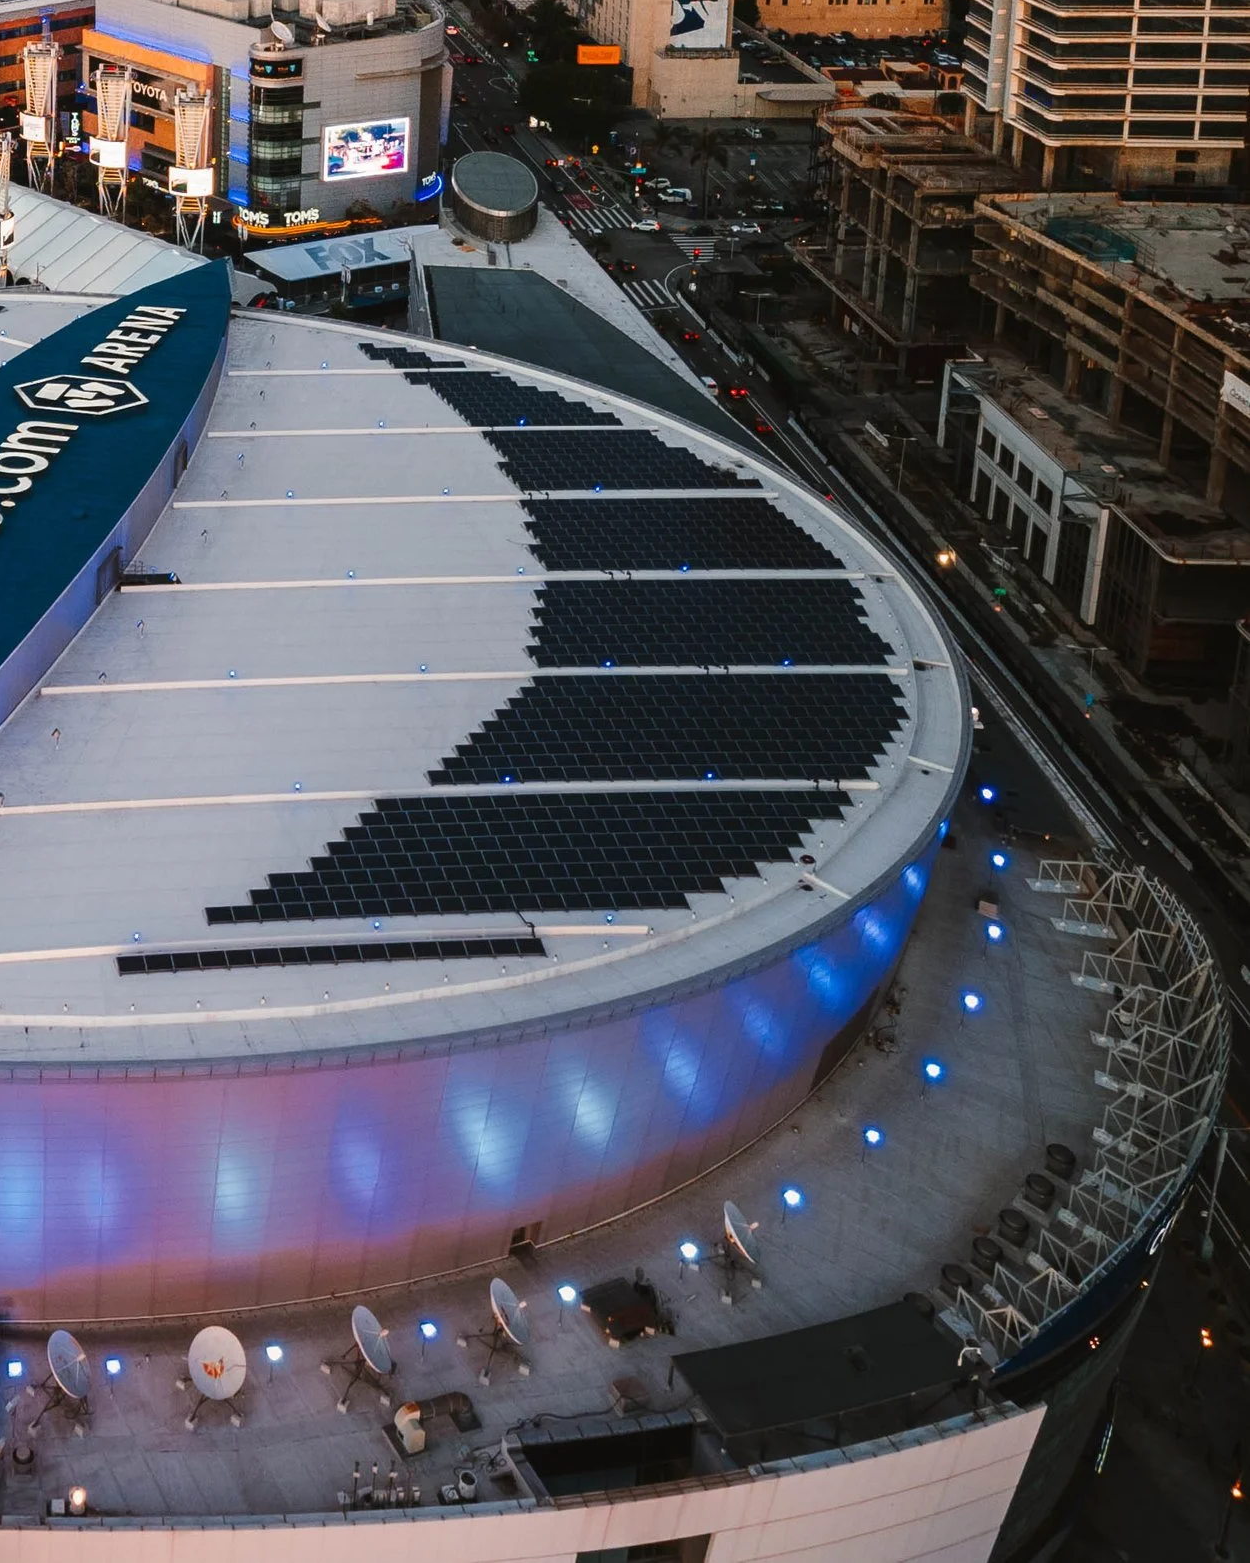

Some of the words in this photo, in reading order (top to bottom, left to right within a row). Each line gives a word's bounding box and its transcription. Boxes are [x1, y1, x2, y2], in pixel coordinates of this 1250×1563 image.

[238, 206, 269, 225] TOM'S
[283, 207, 319, 223] TOM'S
[305, 237, 391, 270] FOX
[80, 304, 188, 375] ARENA
